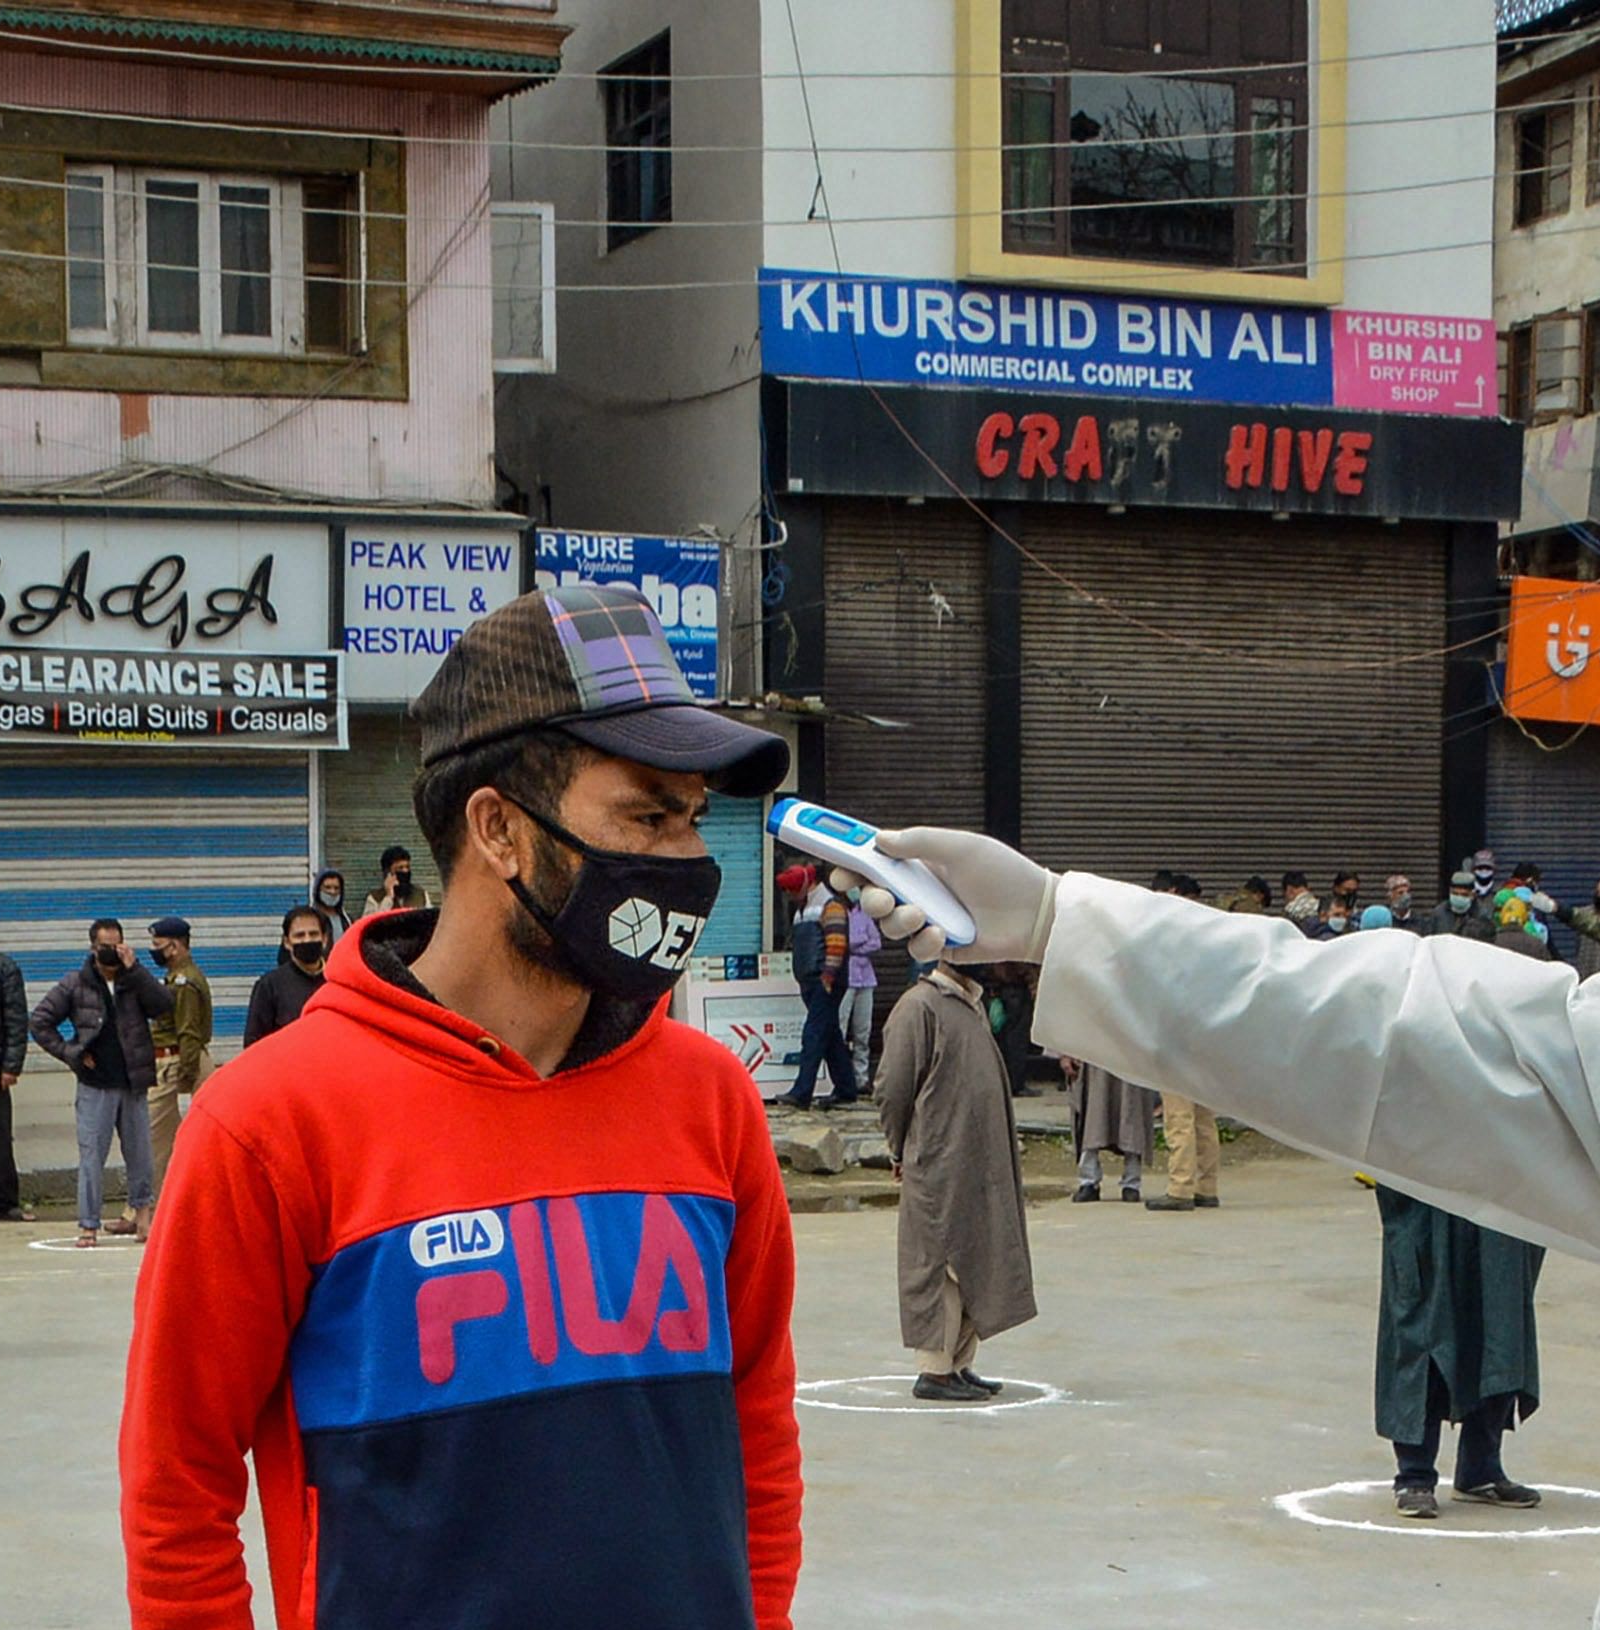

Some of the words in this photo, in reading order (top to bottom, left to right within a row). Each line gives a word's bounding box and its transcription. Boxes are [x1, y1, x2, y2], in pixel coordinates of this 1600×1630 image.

[780, 278, 1097, 350] KHURSHID
[1118, 303, 1212, 359] BIN
[1228, 311, 1318, 365] ALI
[1346, 316, 1483, 342] KHURSHID
[1368, 342, 1412, 362] BIN
[1421, 345, 1462, 365] ALI
[915, 351, 1076, 383] COMMERCIAL
[1081, 362, 1193, 391] COMPLEX
[1370, 366, 1404, 382] DRY
[1410, 367, 1458, 384] FRUIT
[1391, 386, 1439, 402] SHOP
[1224, 423, 1373, 495] HIVE
[350, 541, 426, 569] PEAK
[443, 544, 511, 572] VIEW
[566, 534, 635, 561] PURE
[575, 557, 634, 581] Vegetarian
[364, 584, 455, 612] HOTEL
[469, 586, 487, 613] &
[232, 661, 327, 699] SALE
[68, 701, 139, 727] Bridal
[148, 703, 208, 730] Suits
[231, 705, 328, 732] Casuals
[426, 1216, 491, 1259] FILA
[415, 1194, 709, 1385] FILA
